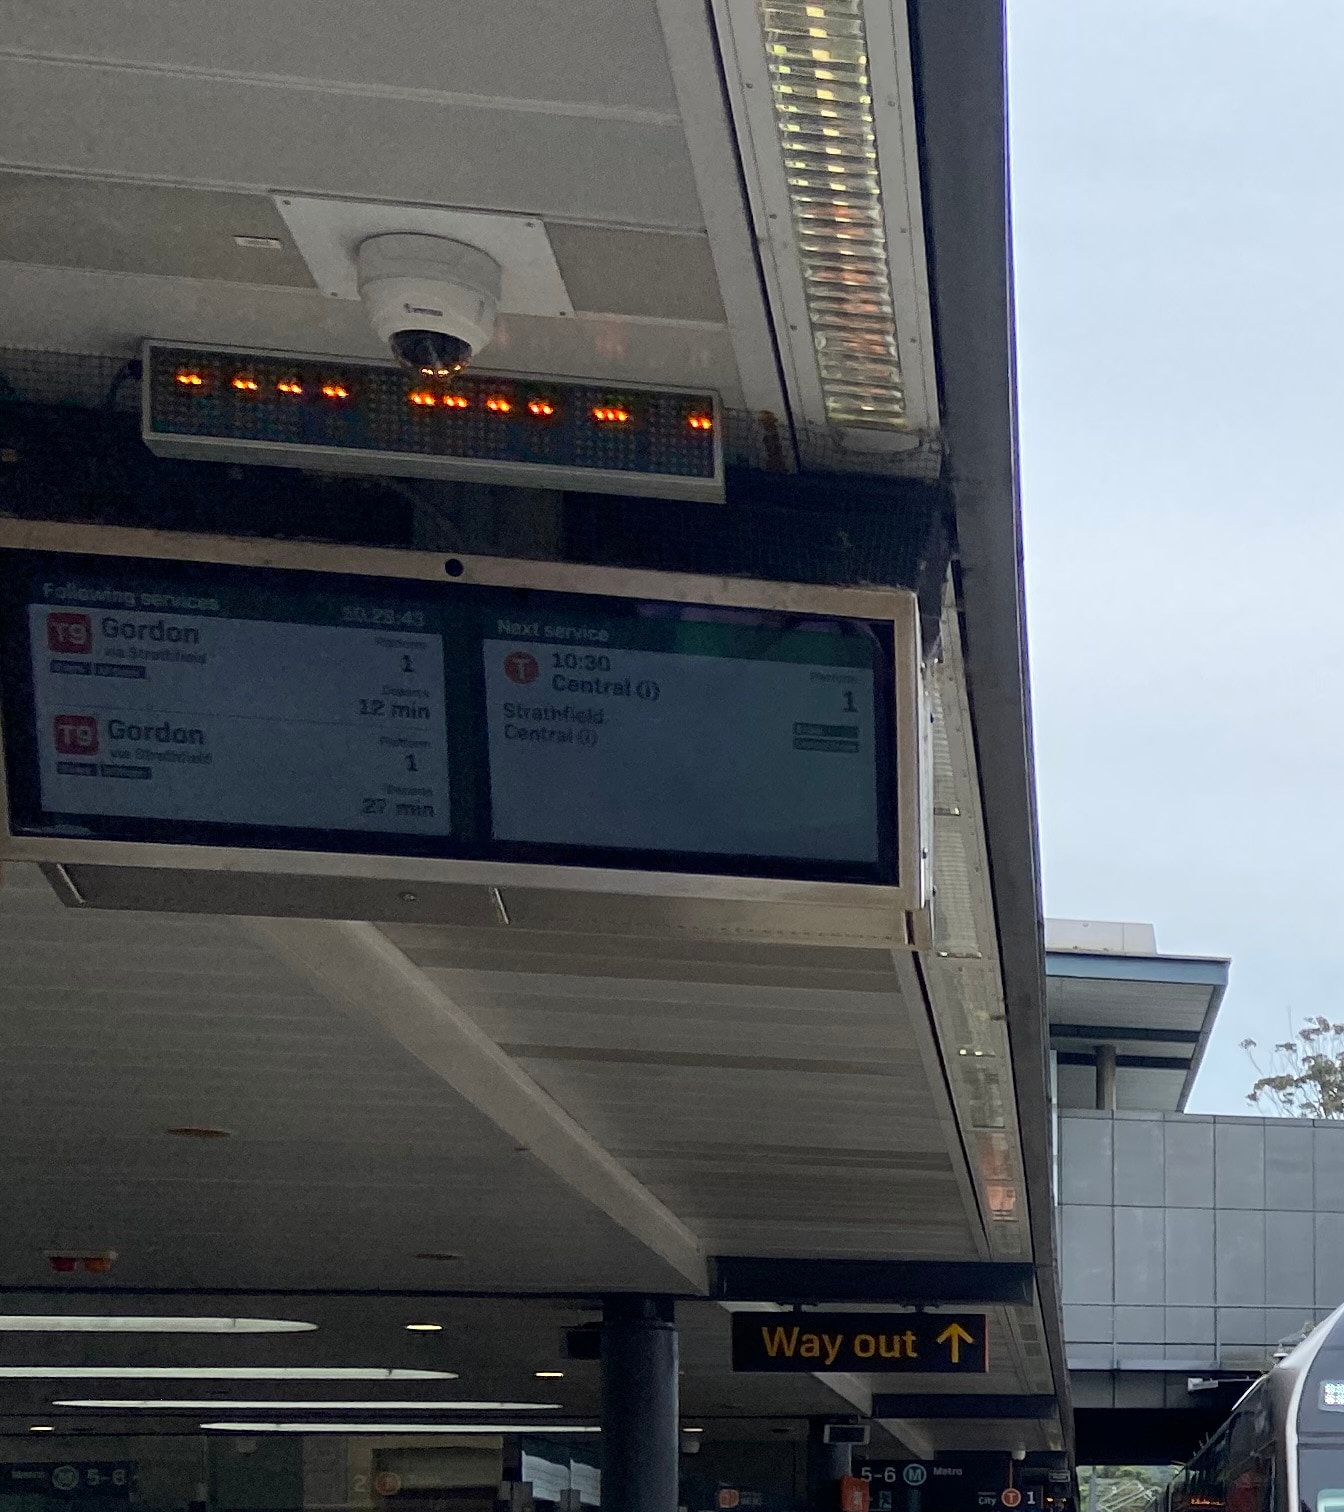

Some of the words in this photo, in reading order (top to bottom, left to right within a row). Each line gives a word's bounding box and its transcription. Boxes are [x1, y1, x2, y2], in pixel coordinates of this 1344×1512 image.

[102, 616, 199, 644] Gordon
[497, 619, 540, 636] Next
[543, 626, 610, 643] service
[402, 654, 414, 673] 1
[552, 652, 611, 672] 10:30
[552, 674, 631, 697] Central
[359, 698, 385, 716] 12
[391, 700, 430, 720] min
[842, 690, 858, 713] 1
[503, 702, 605, 725] Strathfield
[108, 719, 204, 745] Gordon
[504, 724, 573, 744] Central
[405, 754, 418, 772] 1
[395, 800, 434, 818] min
[761, 1326, 843, 1365] Way
[854, 1331, 918, 1359] out
[933, 1466, 963, 1476] Metro
[1027, 1491, 1036, 1505] 1
